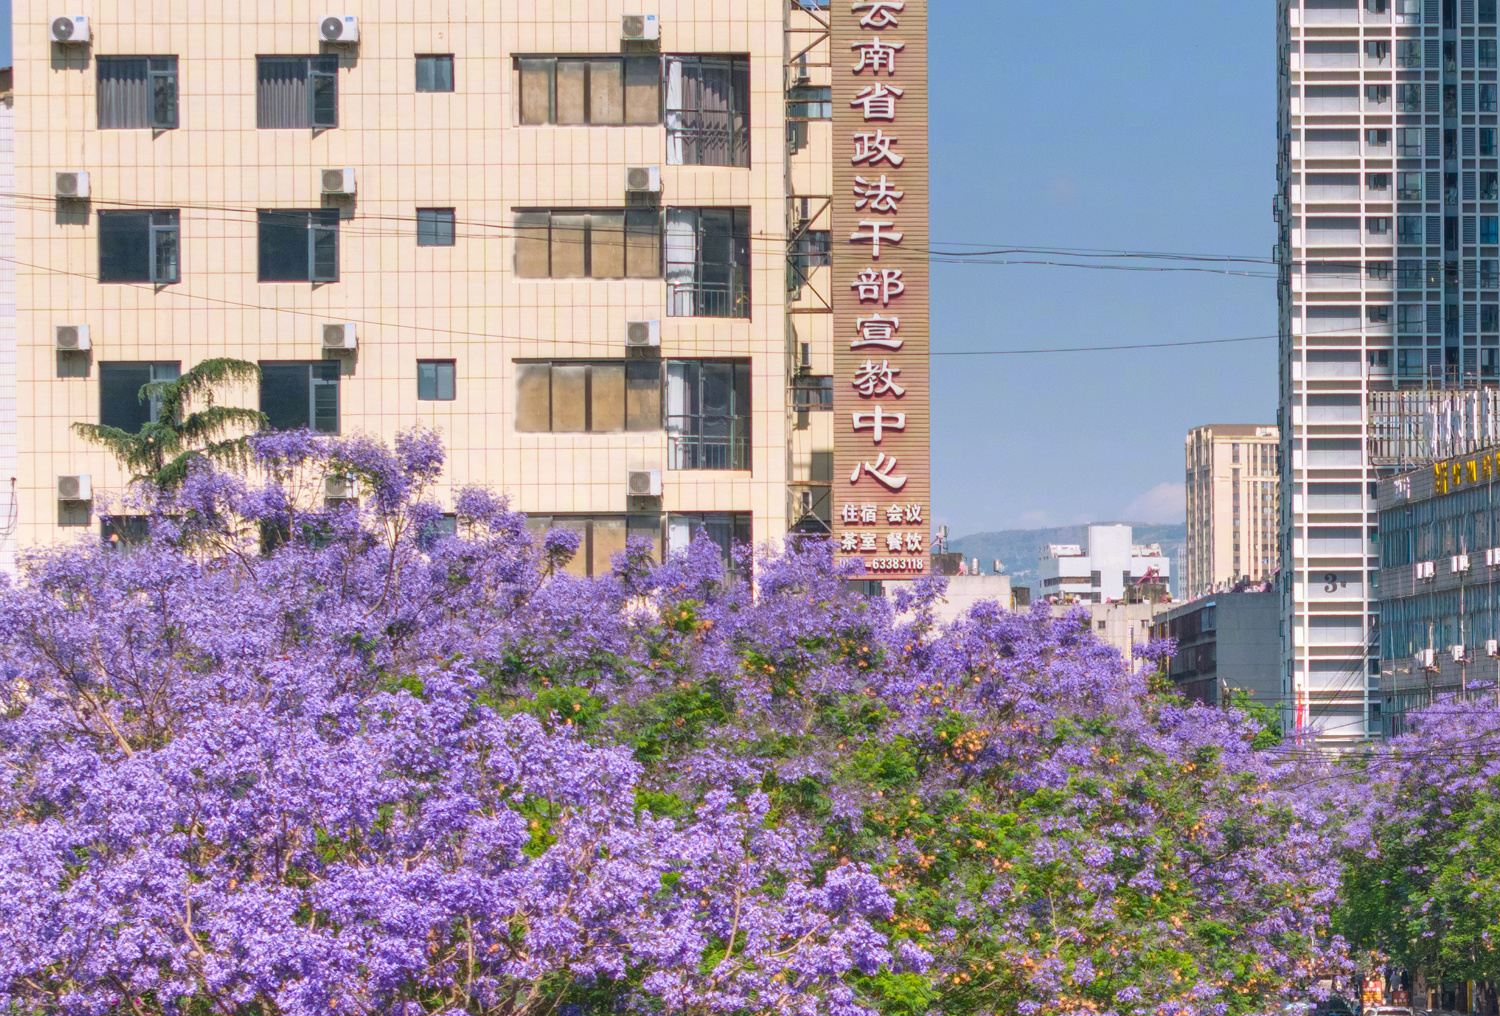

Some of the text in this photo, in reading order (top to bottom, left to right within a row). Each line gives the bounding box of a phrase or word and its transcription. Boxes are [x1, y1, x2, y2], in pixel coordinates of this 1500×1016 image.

[850, 0, 907, 488] 云南省政法干部宣教中心
[841, 504, 922, 523] 住宿 会议
[841, 531, 922, 551] 茶室 餐饮
[840, 558, 923, 571] 0-63383118
